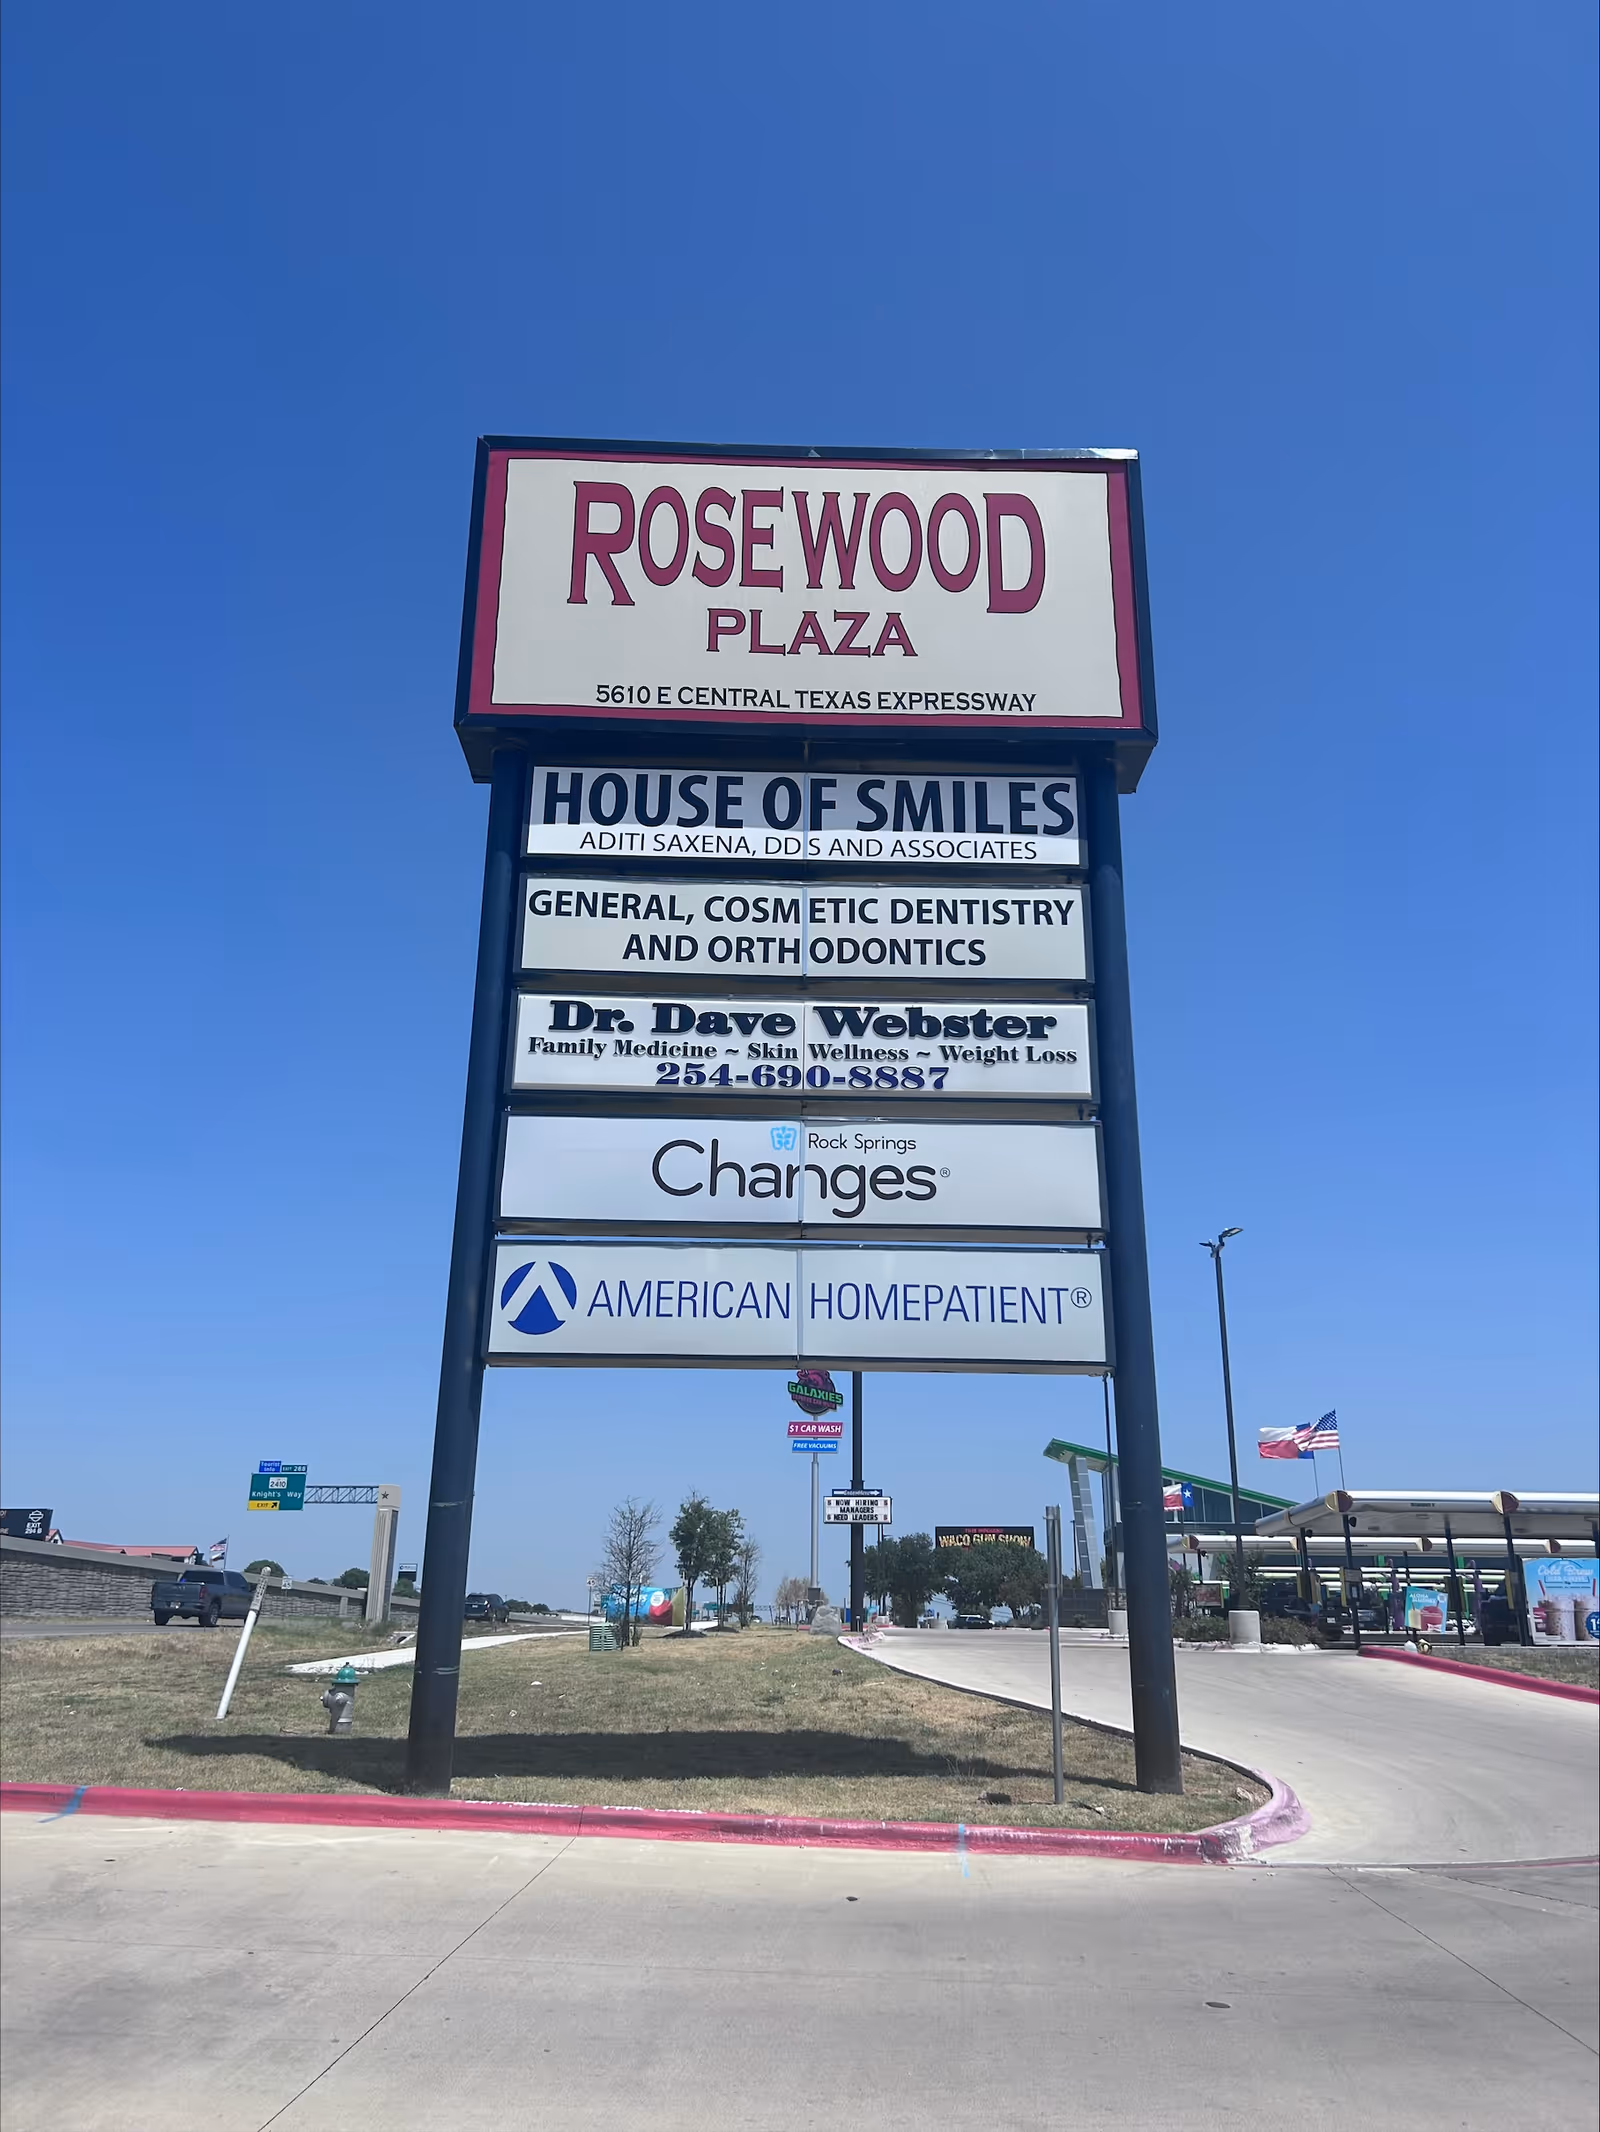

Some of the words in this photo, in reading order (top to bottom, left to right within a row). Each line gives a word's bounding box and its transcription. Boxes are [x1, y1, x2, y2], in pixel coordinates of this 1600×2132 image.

[567, 481, 1045, 614] ROSEWOOD
[706, 608, 919, 658] PLAZA
[595, 684, 650, 704] 5610
[657, 686, 672, 706] E
[678, 686, 790, 709] CENTRAL
[793, 690, 872, 711] TEXAS
[877, 691, 1037, 712] EXPRESSWAY
[542, 772, 743, 829] HOUSE
[762, 777, 838, 831] OF
[857, 779, 1075, 835] SMILES
[580, 831, 646, 851] ADITI
[653, 833, 757, 858] SAXENA,
[828, 838, 884, 858] AND
[890, 839, 1037, 860] ASSOCIATES
[528, 889, 694, 927] GENERAL,
[704, 896, 878, 925] COSMETIC
[890, 898, 1074, 927] DENTISTRY
[623, 934, 698, 962] AND
[708, 935, 986, 966] ORTHODONTICS
[549, 1000, 634, 1034] Dr.
[652, 1003, 796, 1036] Dave
[813, 1006, 1057, 1041] Webster
[528, 1037, 607, 1058] Family
[613, 1039, 717, 1058] Medicine
[748, 1041, 798, 1059] Skin
[809, 1043, 908, 1062] Wellness
[939, 1044, 1018, 1065] Weight
[1025, 1046, 1077, 1063] Loss
[656, 1063, 949, 1090] 254-690-8887
[808, 1133, 847, 1150] Rock
[854, 1134, 917, 1154] Springs
[587, 1281, 790, 1318] AMERICAN
[789, 1382, 842, 1403] GALAXIES
[789, 1424, 799, 1432] $1
[287, 1491, 302, 1499] Way
[939, 1534, 971, 1547] WACO
